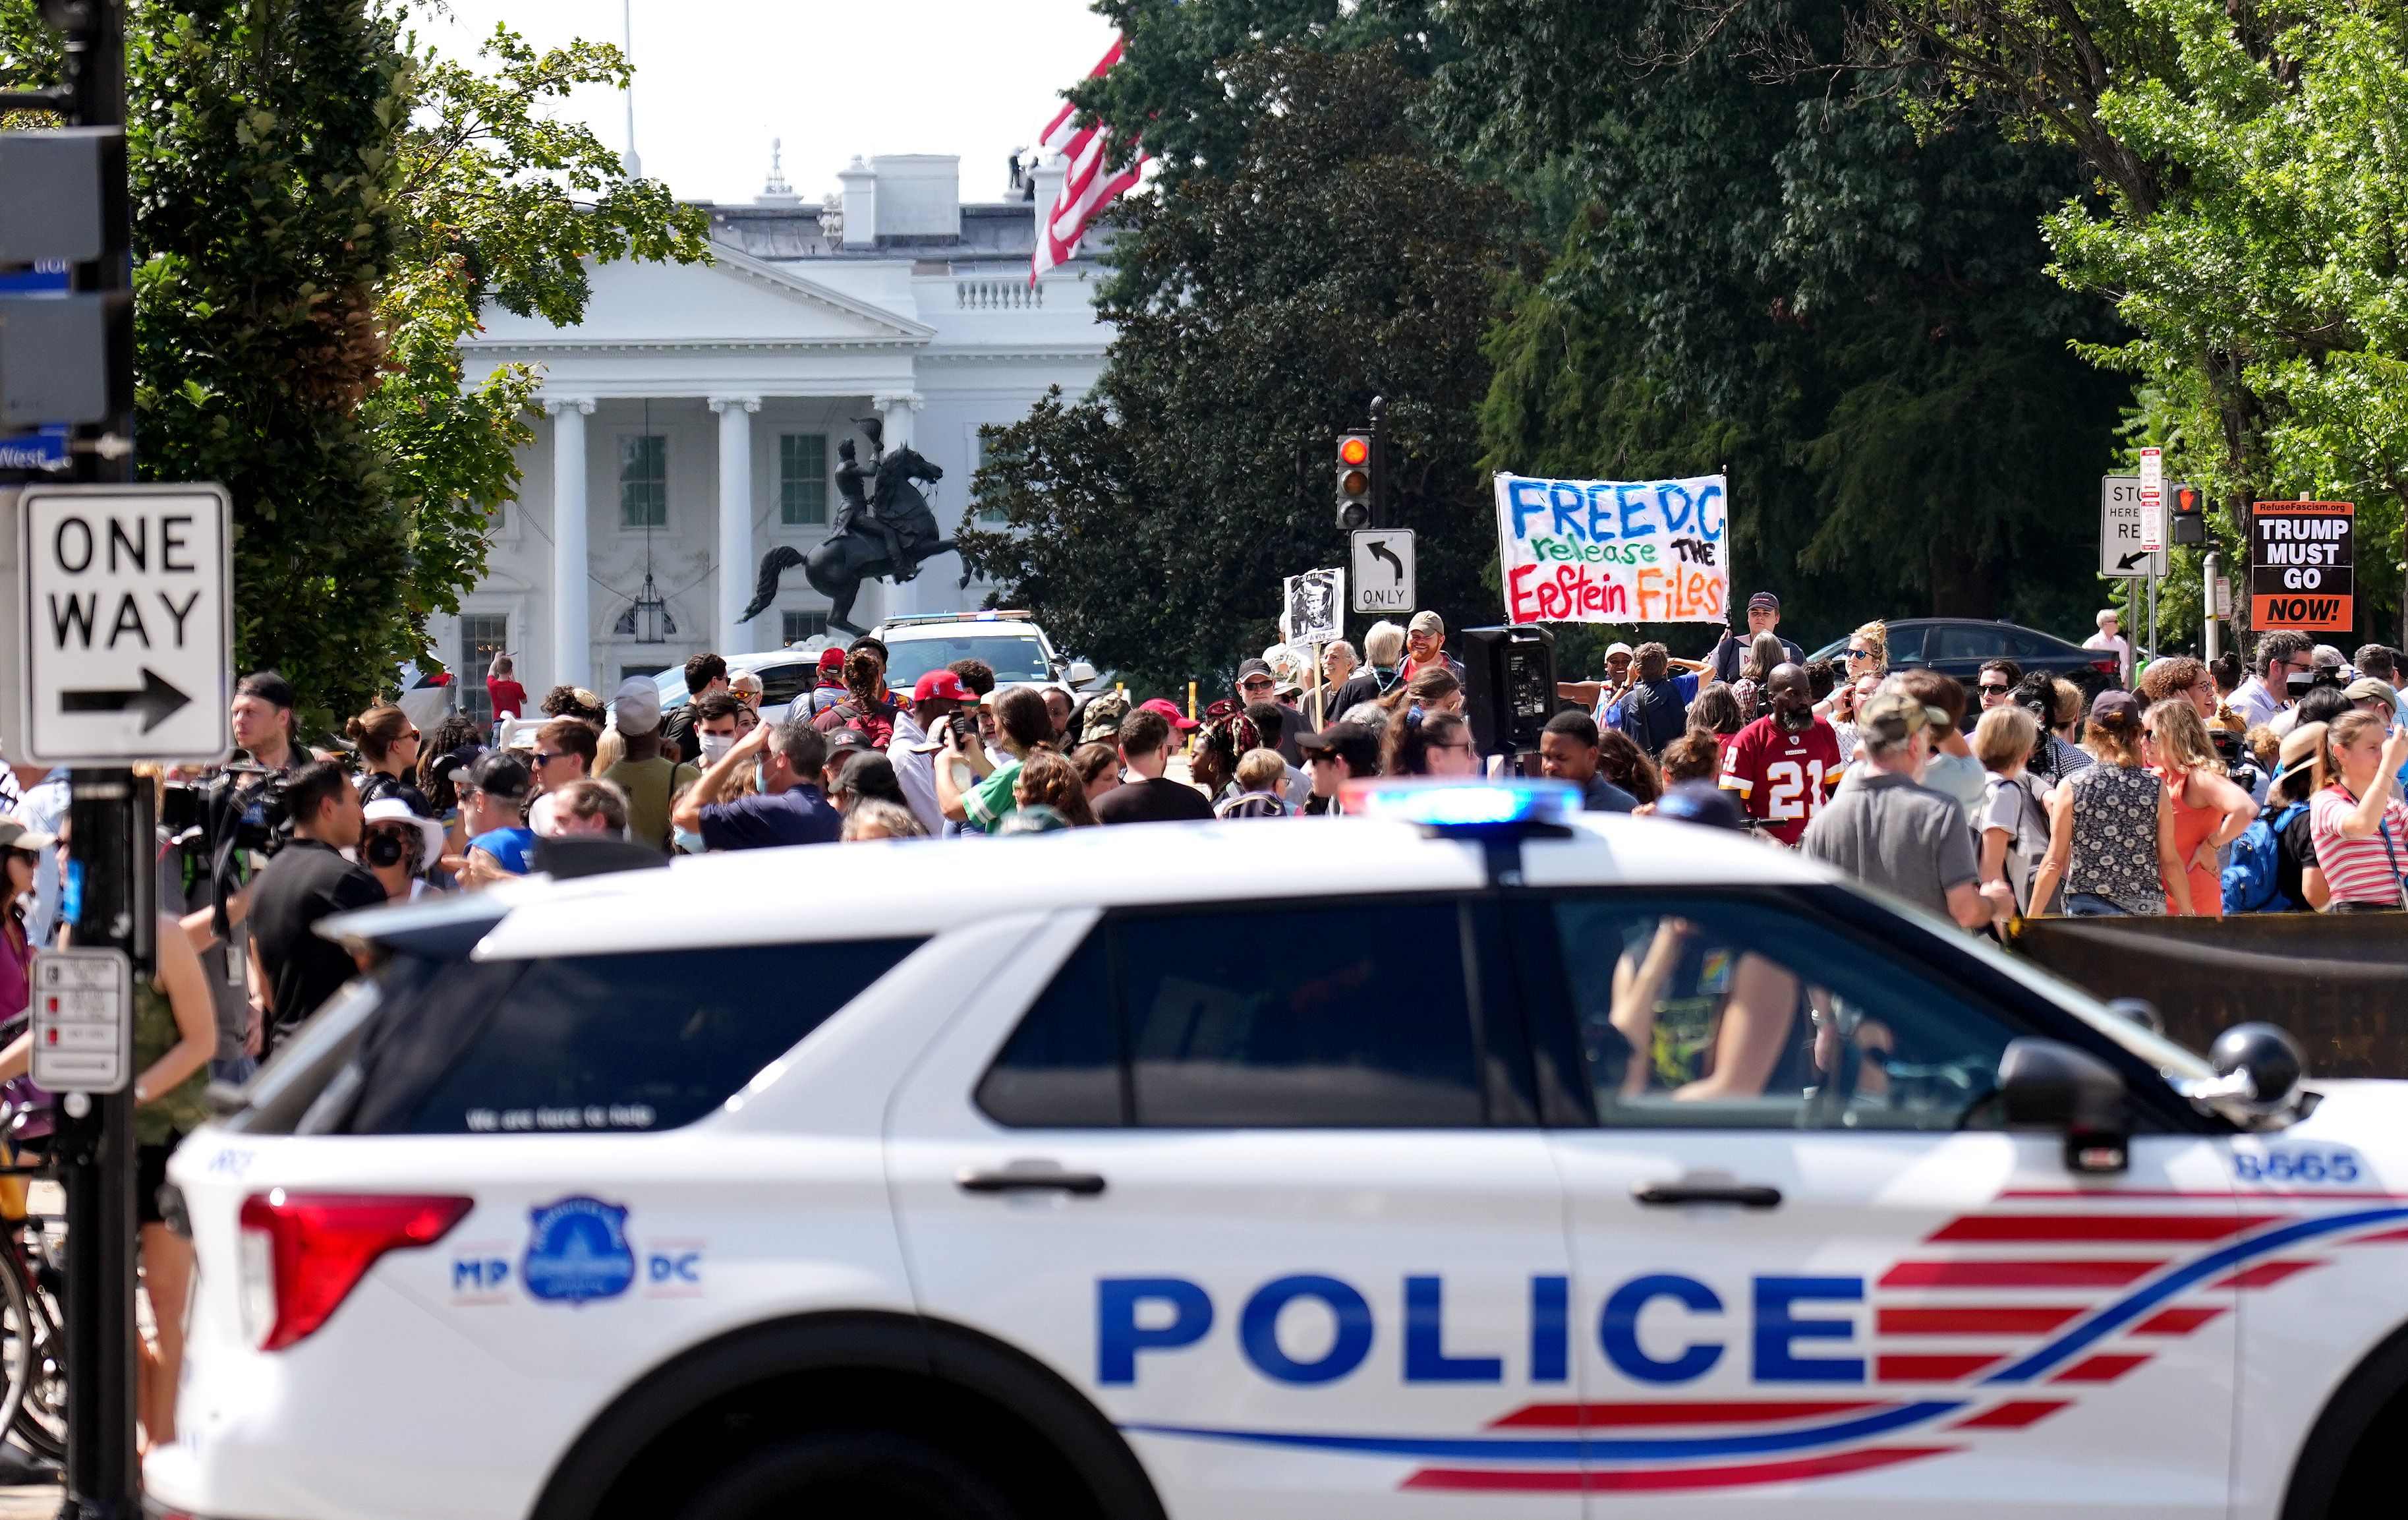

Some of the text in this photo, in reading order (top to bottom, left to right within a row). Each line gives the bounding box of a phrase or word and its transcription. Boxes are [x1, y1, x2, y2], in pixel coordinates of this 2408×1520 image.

[2113, 486, 2140, 501] ST
[1509, 481, 1655, 542] FREE
[2109, 508, 2139, 517] HERE
[2260, 502, 2345, 512] RefuseFascism.org
[2118, 523, 2140, 539] RE
[2258, 519, 2349, 540] TRUMP
[53, 516, 196, 575] ONE
[1531, 533, 1715, 566] release THE
[2267, 542, 2339, 565] MUST
[2283, 568, 2322, 589] GO
[1363, 590, 1404, 604] ONLY
[1509, 564, 1626, 624] Epstein
[46, 591, 200, 650] WAY
[2267, 599, 2340, 622] NOW!
[1766, 759, 1823, 819] 21
[454, 1254, 701, 1289] MP DC
[1096, 1274, 1867, 1386] POLICE
